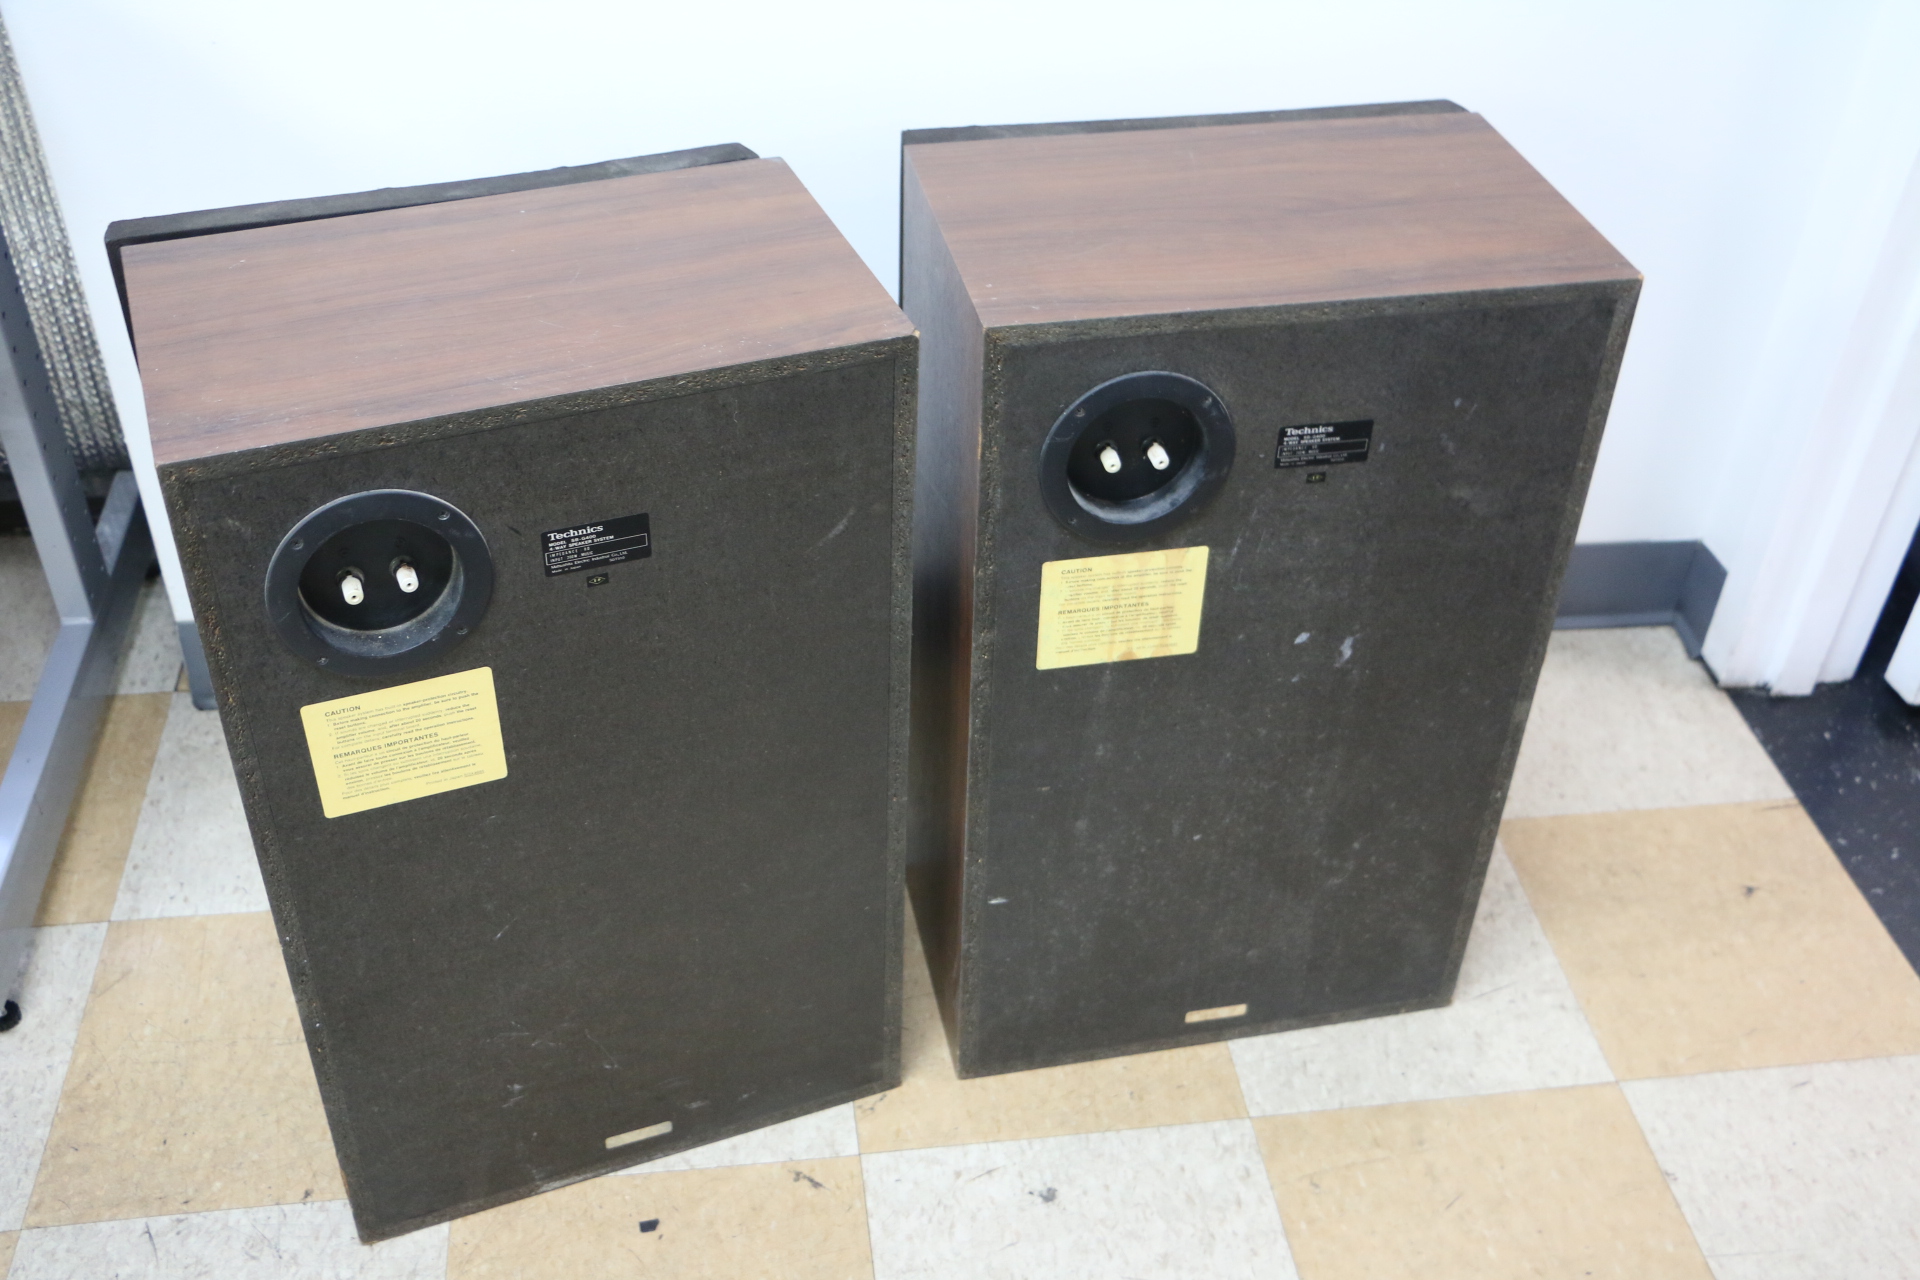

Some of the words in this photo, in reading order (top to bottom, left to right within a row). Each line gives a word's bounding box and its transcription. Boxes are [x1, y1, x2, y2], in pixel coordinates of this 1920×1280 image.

[1285, 425, 1334, 436] Technics
[547, 525, 604, 541] Technics
[568, 540, 592, 548] SPEAKER
[1061, 567, 1093, 575] CAUTION
[1057, 606, 1100, 615] REMARQUES
[324, 705, 361, 717] CAUTION
[333, 744, 383, 759] REMARQUES
[384, 731, 439, 748] IMPORTANTES
